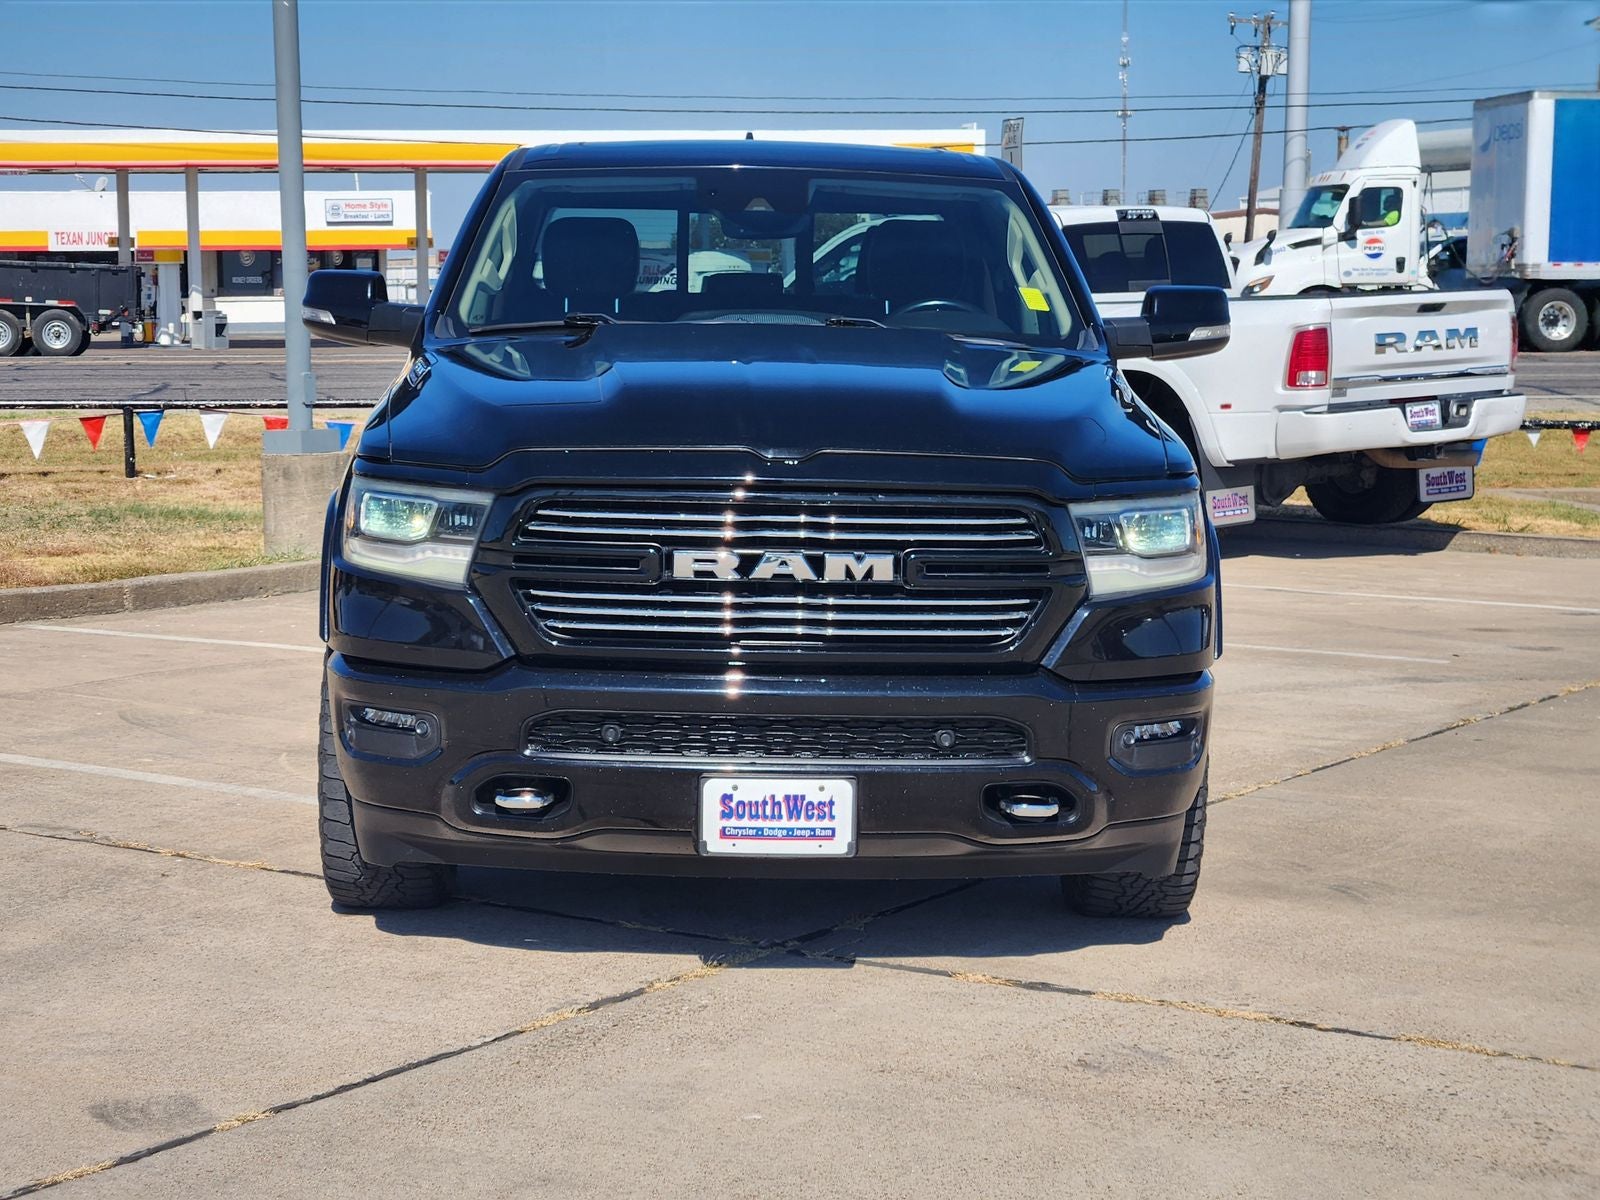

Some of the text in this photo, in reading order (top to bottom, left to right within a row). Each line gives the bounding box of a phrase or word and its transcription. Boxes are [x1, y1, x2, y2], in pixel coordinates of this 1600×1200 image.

[369, 201, 389, 210] Style
[55, 231, 82, 245] TEXAN
[1375, 327, 1478, 355] RAM
[1425, 470, 1466, 487] SouthWest
[1212, 492, 1249, 509] SouthWest
[672, 550, 895, 582] RAM
[719, 793, 836, 822] SouthWest
[725, 827, 832, 838] Chrysler Dodge Jeep Ram
